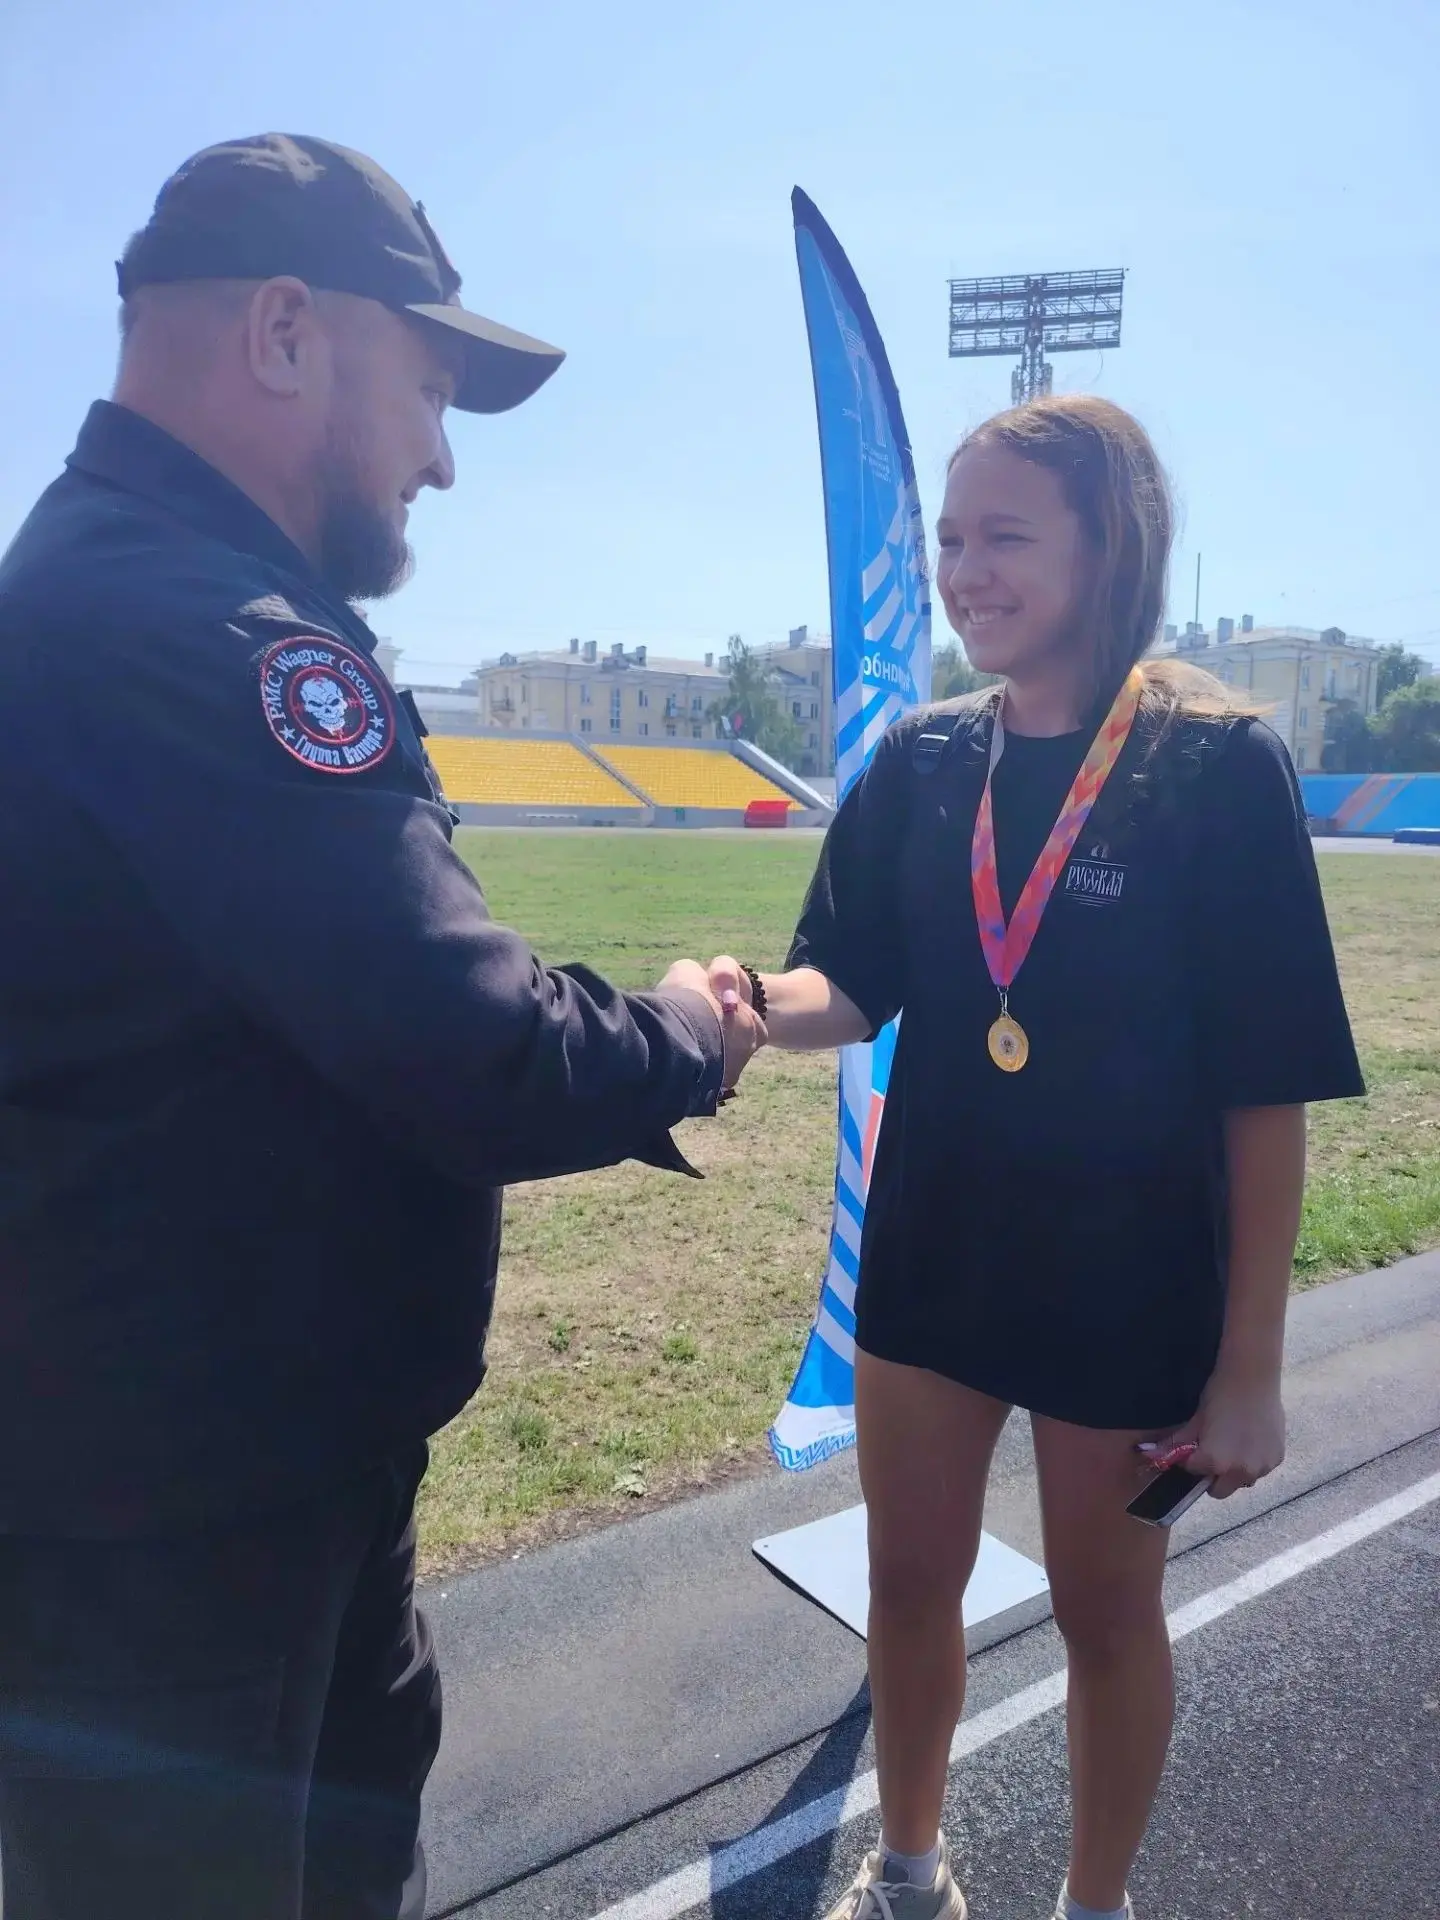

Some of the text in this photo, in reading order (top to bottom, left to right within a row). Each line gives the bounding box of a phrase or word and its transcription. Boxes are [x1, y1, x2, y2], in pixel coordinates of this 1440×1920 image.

[265, 649, 378, 720] PMC Wagner Group
[295, 730, 383, 765] Группа Вагнера
[1066, 866, 1124, 897] РУССКАЯ
